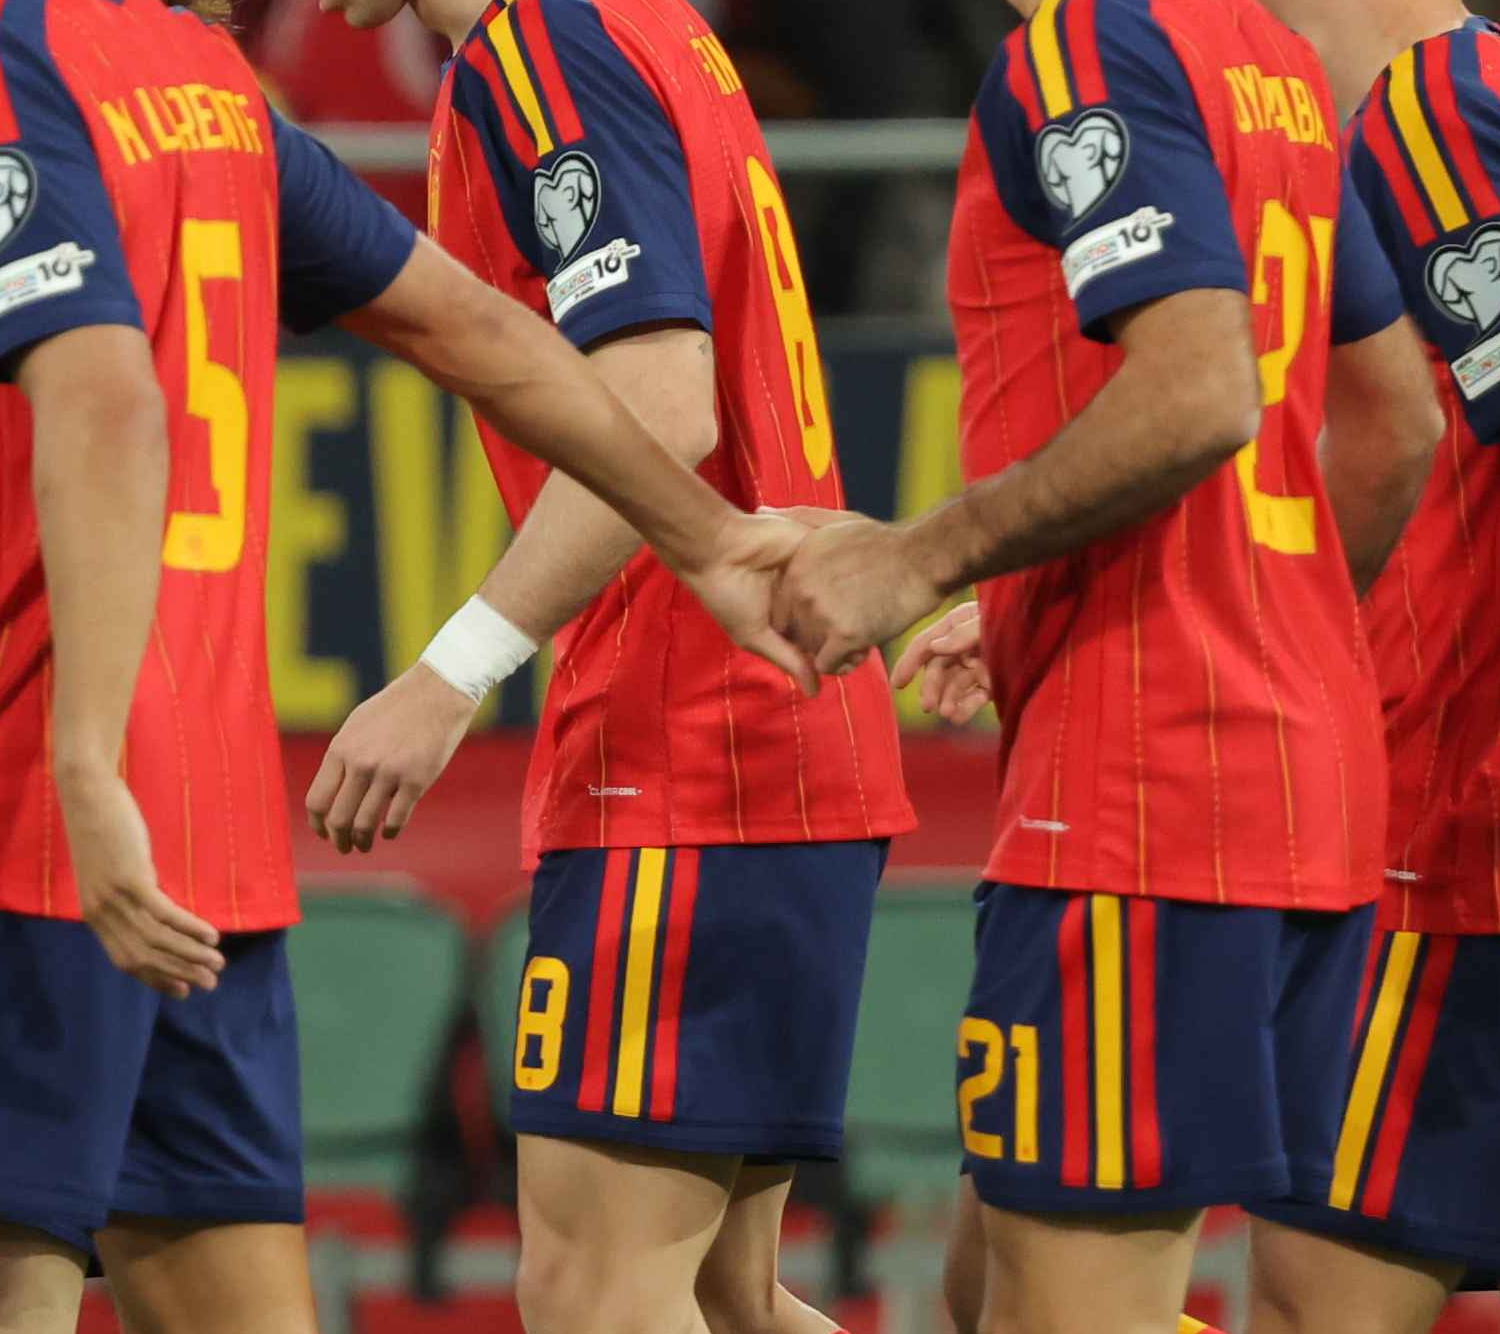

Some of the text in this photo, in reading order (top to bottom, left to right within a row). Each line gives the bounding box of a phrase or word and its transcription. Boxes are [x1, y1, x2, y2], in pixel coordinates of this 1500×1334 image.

[163, 219, 249, 573] 5
[745, 155, 833, 481] 8
[515, 956, 571, 1092] 8
[957, 1017, 1040, 1164] 21
